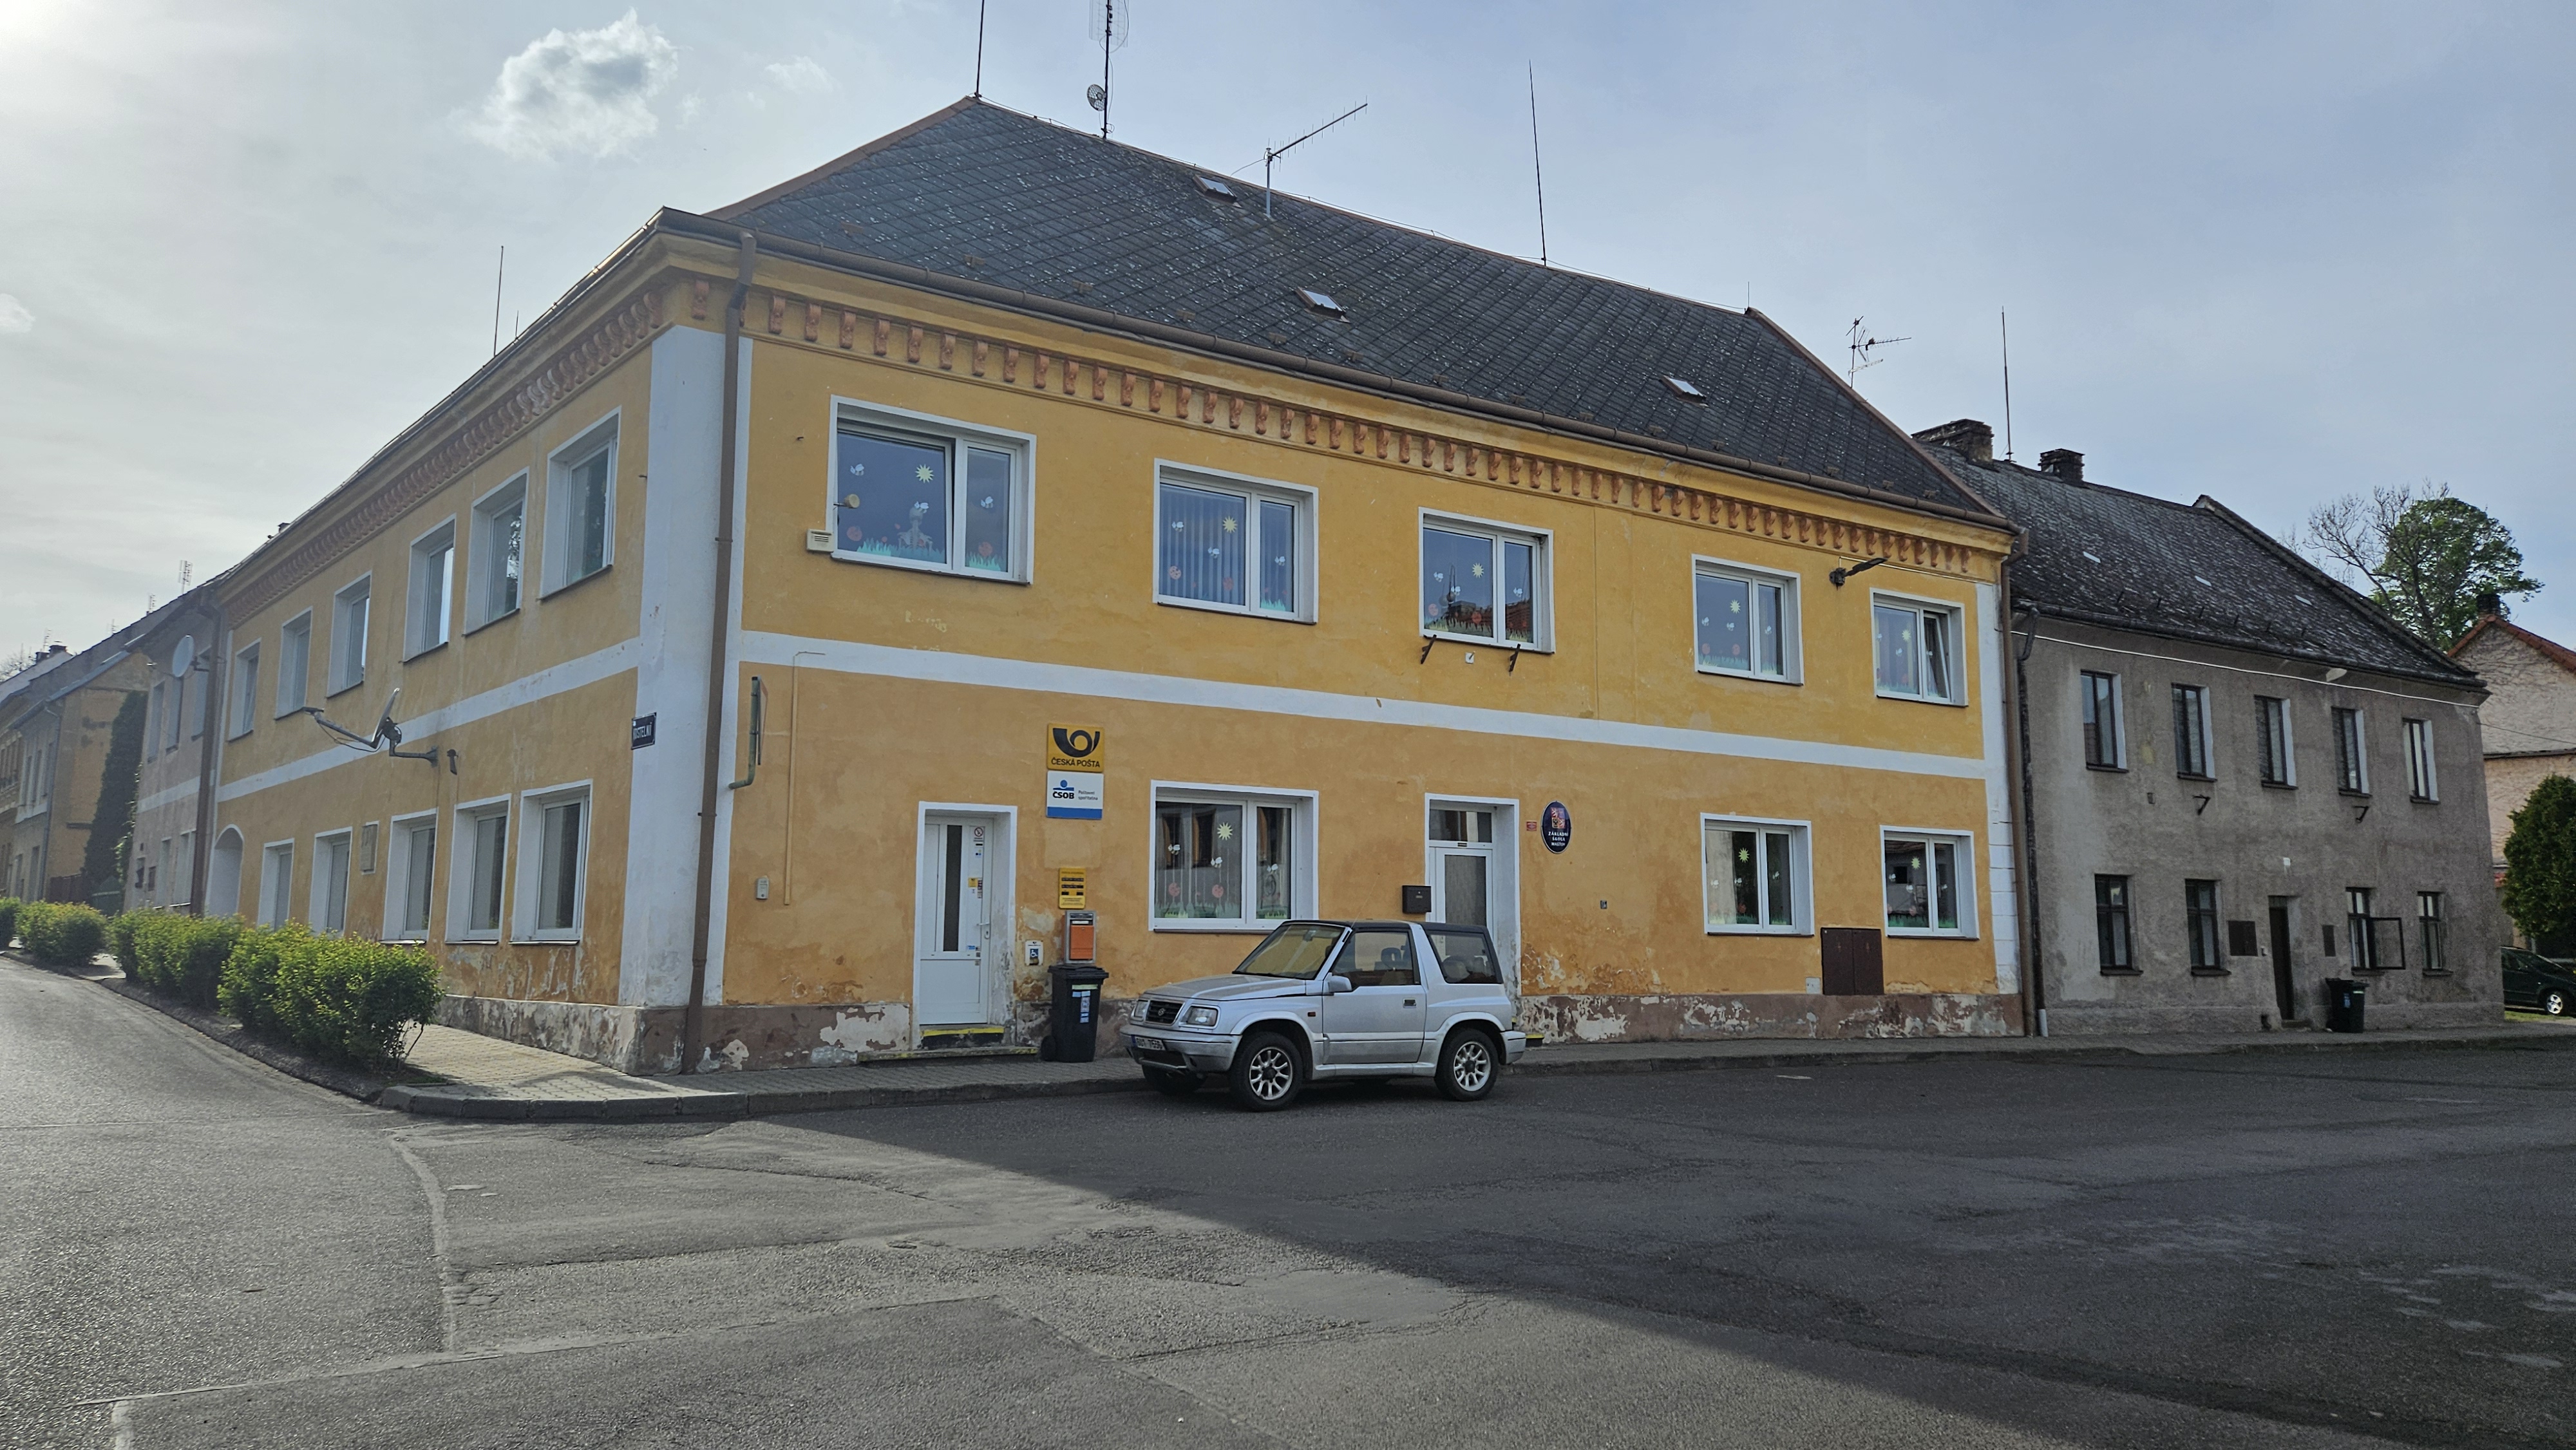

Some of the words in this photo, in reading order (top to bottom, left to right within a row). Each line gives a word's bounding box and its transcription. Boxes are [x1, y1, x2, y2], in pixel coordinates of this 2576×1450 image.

[1051, 757, 1075, 766] ČESKÁ
[1077, 759, 1100, 767] POŠTA
[1052, 791, 1074, 799] ČSOB
